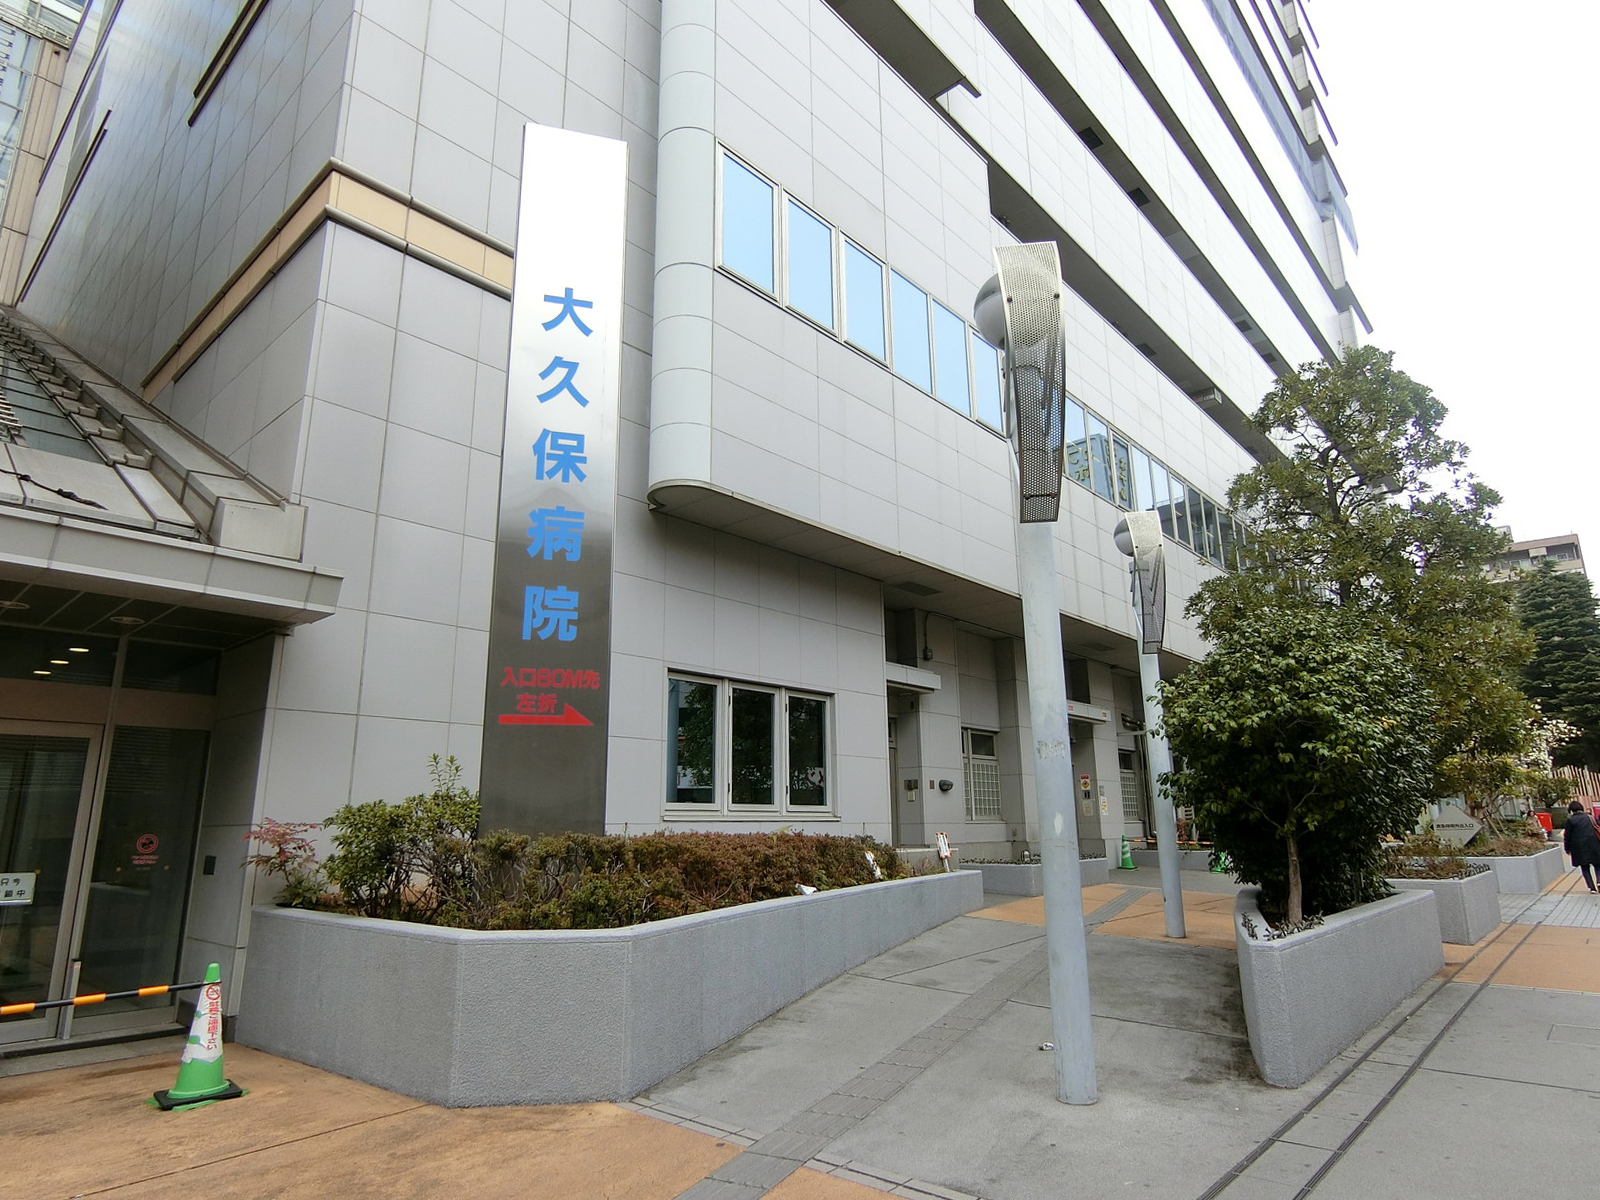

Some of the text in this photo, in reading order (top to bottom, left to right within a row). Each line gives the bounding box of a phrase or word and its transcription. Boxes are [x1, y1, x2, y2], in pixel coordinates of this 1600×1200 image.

[521, 287, 593, 642] 大久保病院
[501, 667, 600, 690] 入口60M先
[515, 692, 557, 713] 左折
